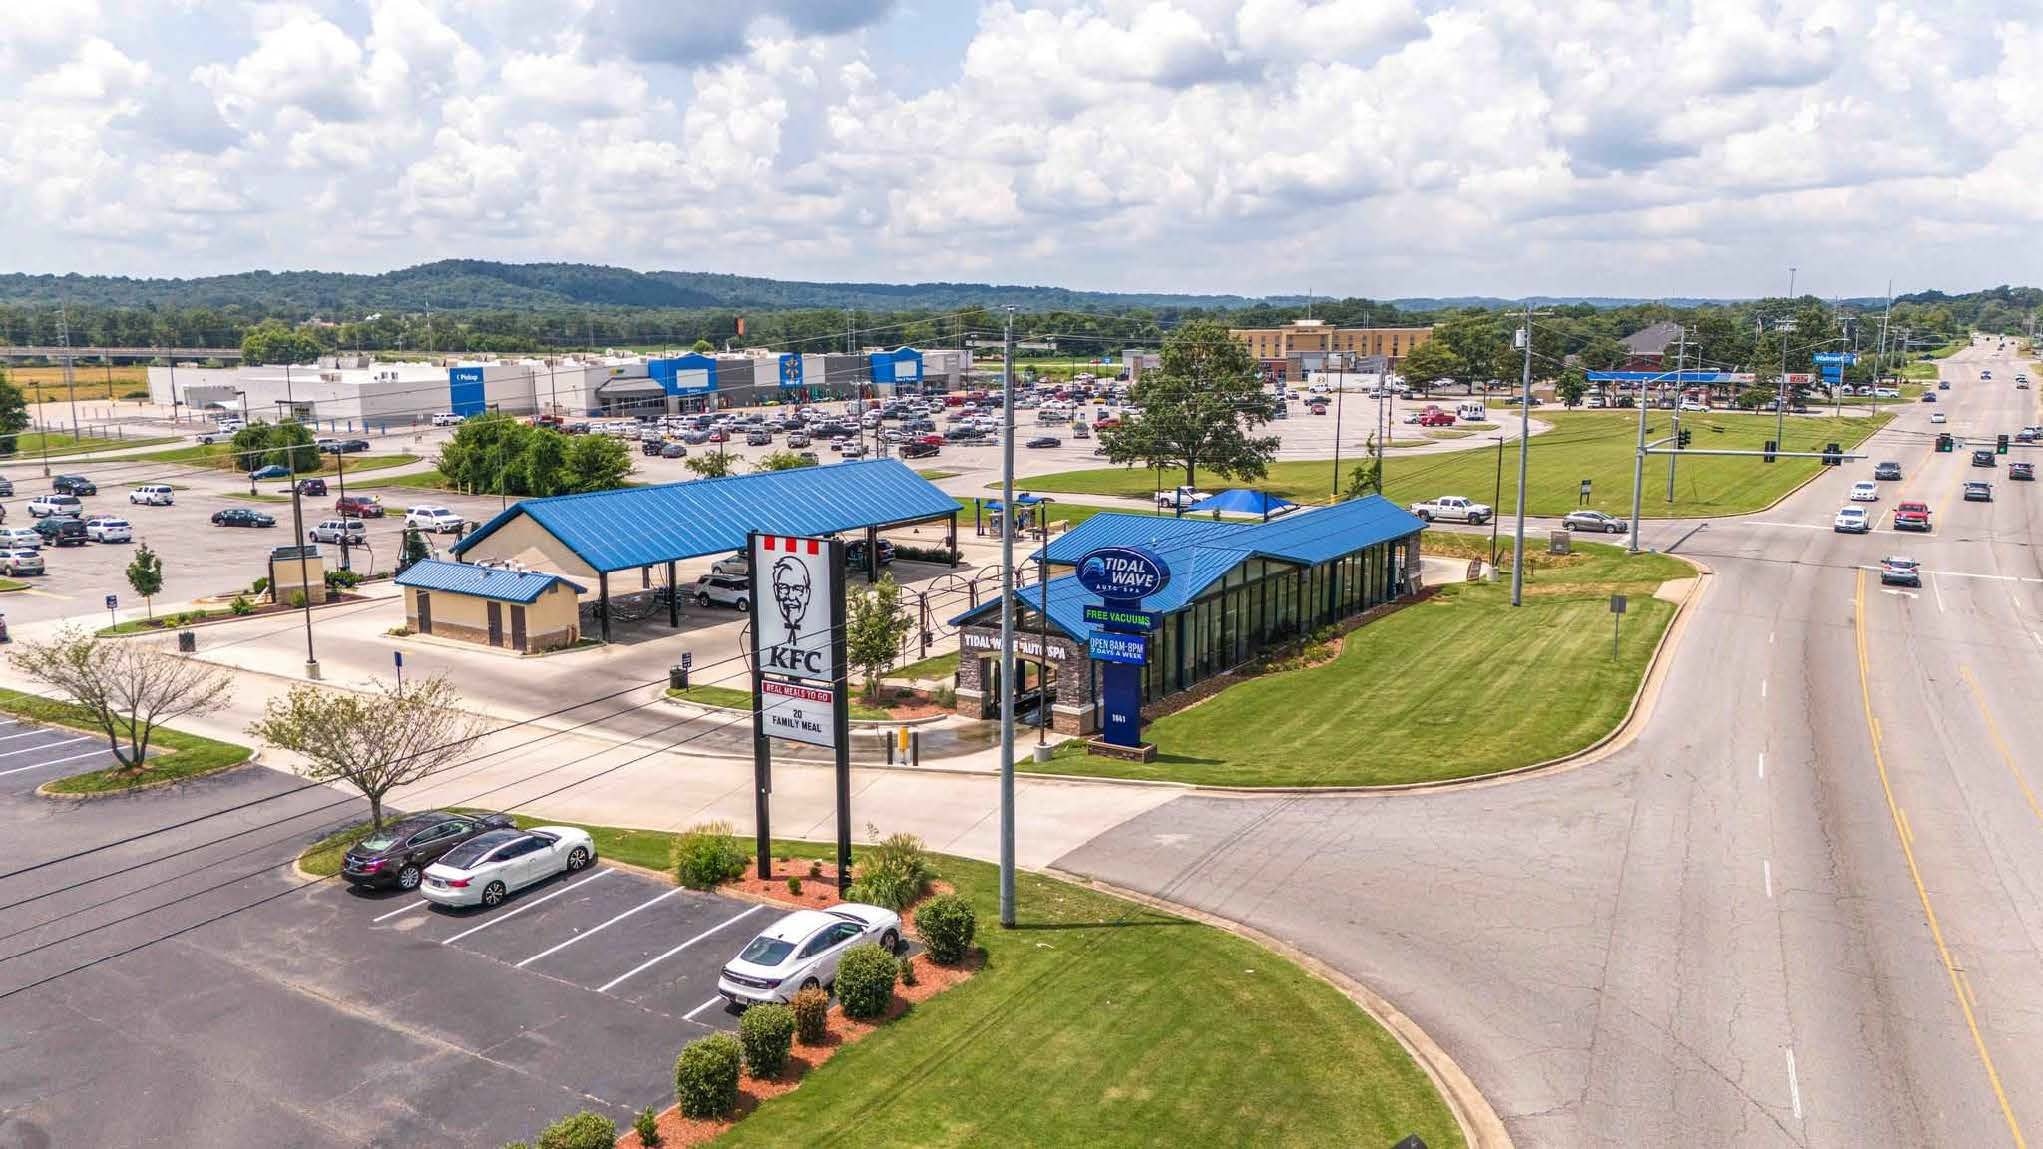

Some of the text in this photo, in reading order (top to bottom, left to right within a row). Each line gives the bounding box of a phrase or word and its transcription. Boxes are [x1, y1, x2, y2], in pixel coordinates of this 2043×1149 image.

[1105, 558, 1145, 573] TIDAL
[1112, 571, 1153, 587] WAVE
[1086, 609, 1151, 626] FREE VACUUMS
[965, 634, 991, 648] TIDAL
[1046, 645, 1065, 659] SPA
[1090, 637, 1144, 654] OPEN 8AM-8PM
[1096, 648, 1114, 656] DAYS
[1122, 652, 1142, 660] WEEK
[769, 645, 821, 674] KFC
[766, 684, 828, 702] REAL MEALS TO GO
[793, 709, 802, 719] 20
[772, 715, 822, 733] FAMILY MEAL
